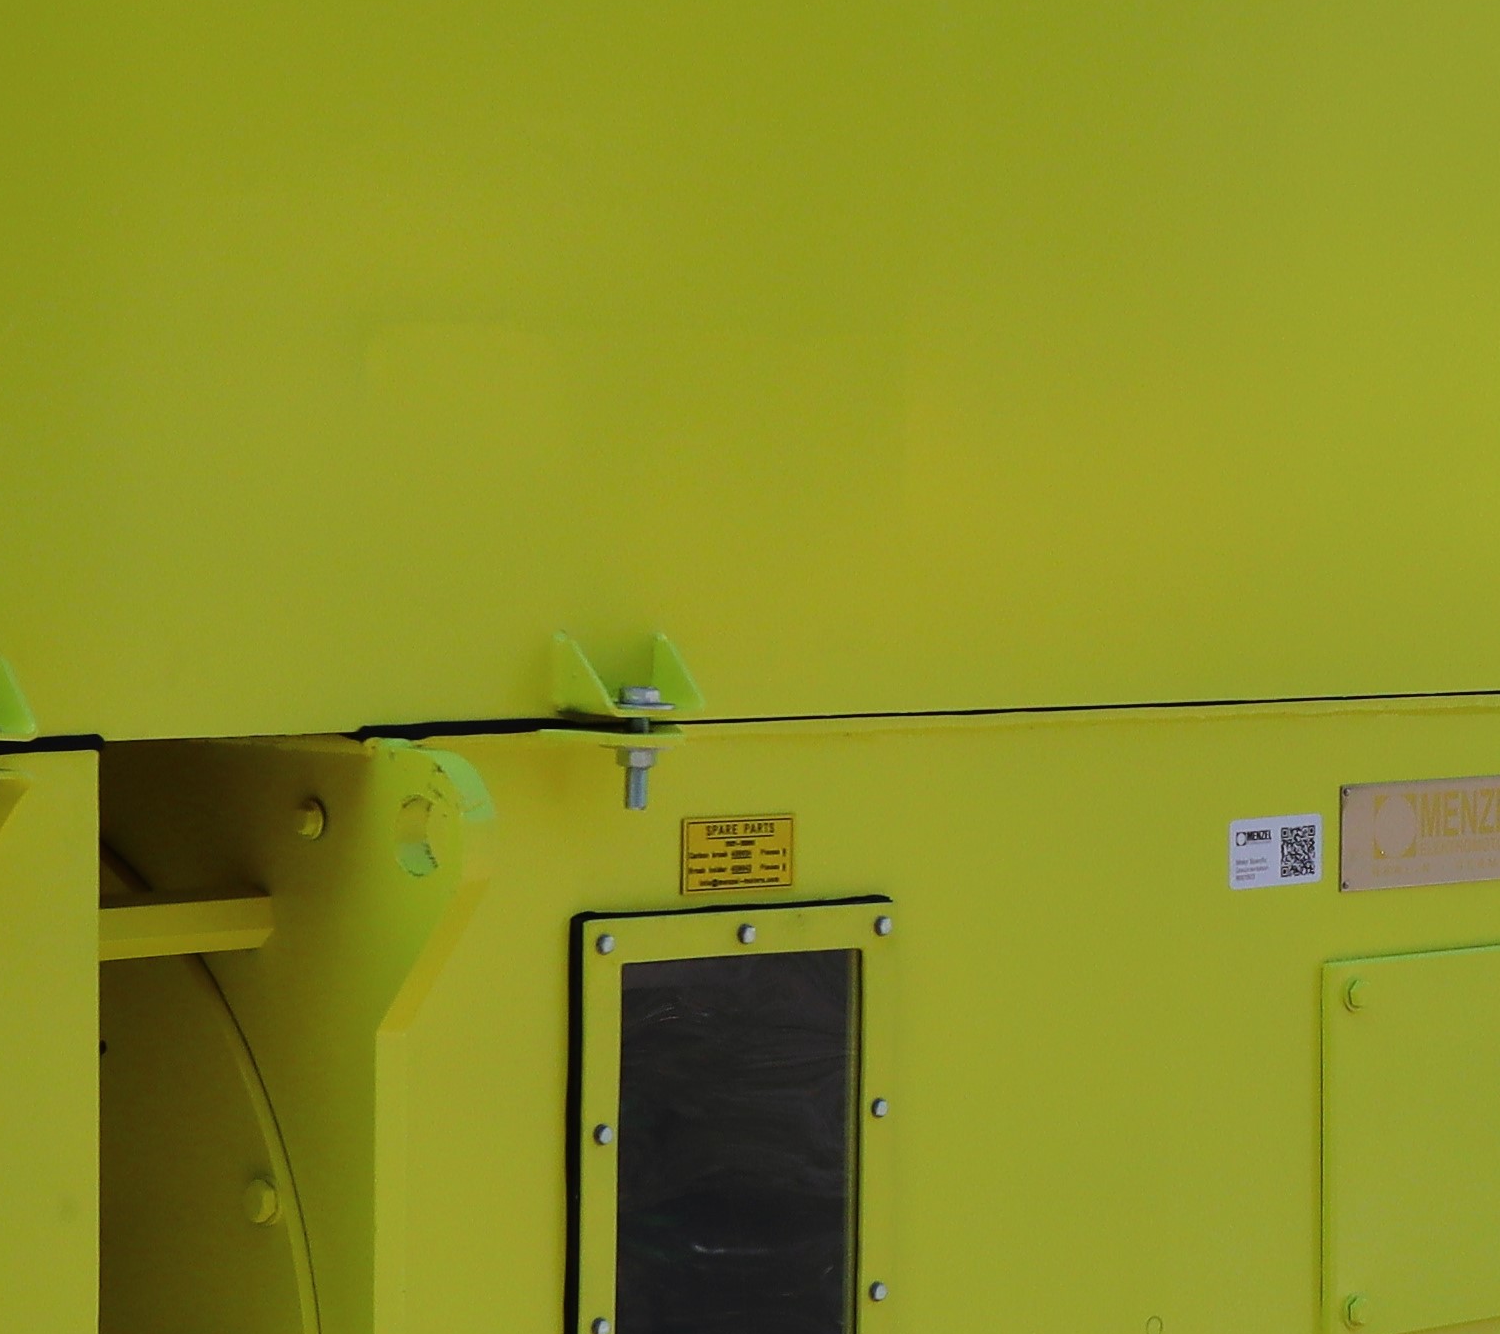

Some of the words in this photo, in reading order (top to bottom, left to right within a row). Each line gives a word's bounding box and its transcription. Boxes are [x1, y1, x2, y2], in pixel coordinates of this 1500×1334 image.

[706, 824, 738, 837] SPARE
[744, 822, 775, 834] PARTS
[1247, 830, 1272, 841] MENZEL
